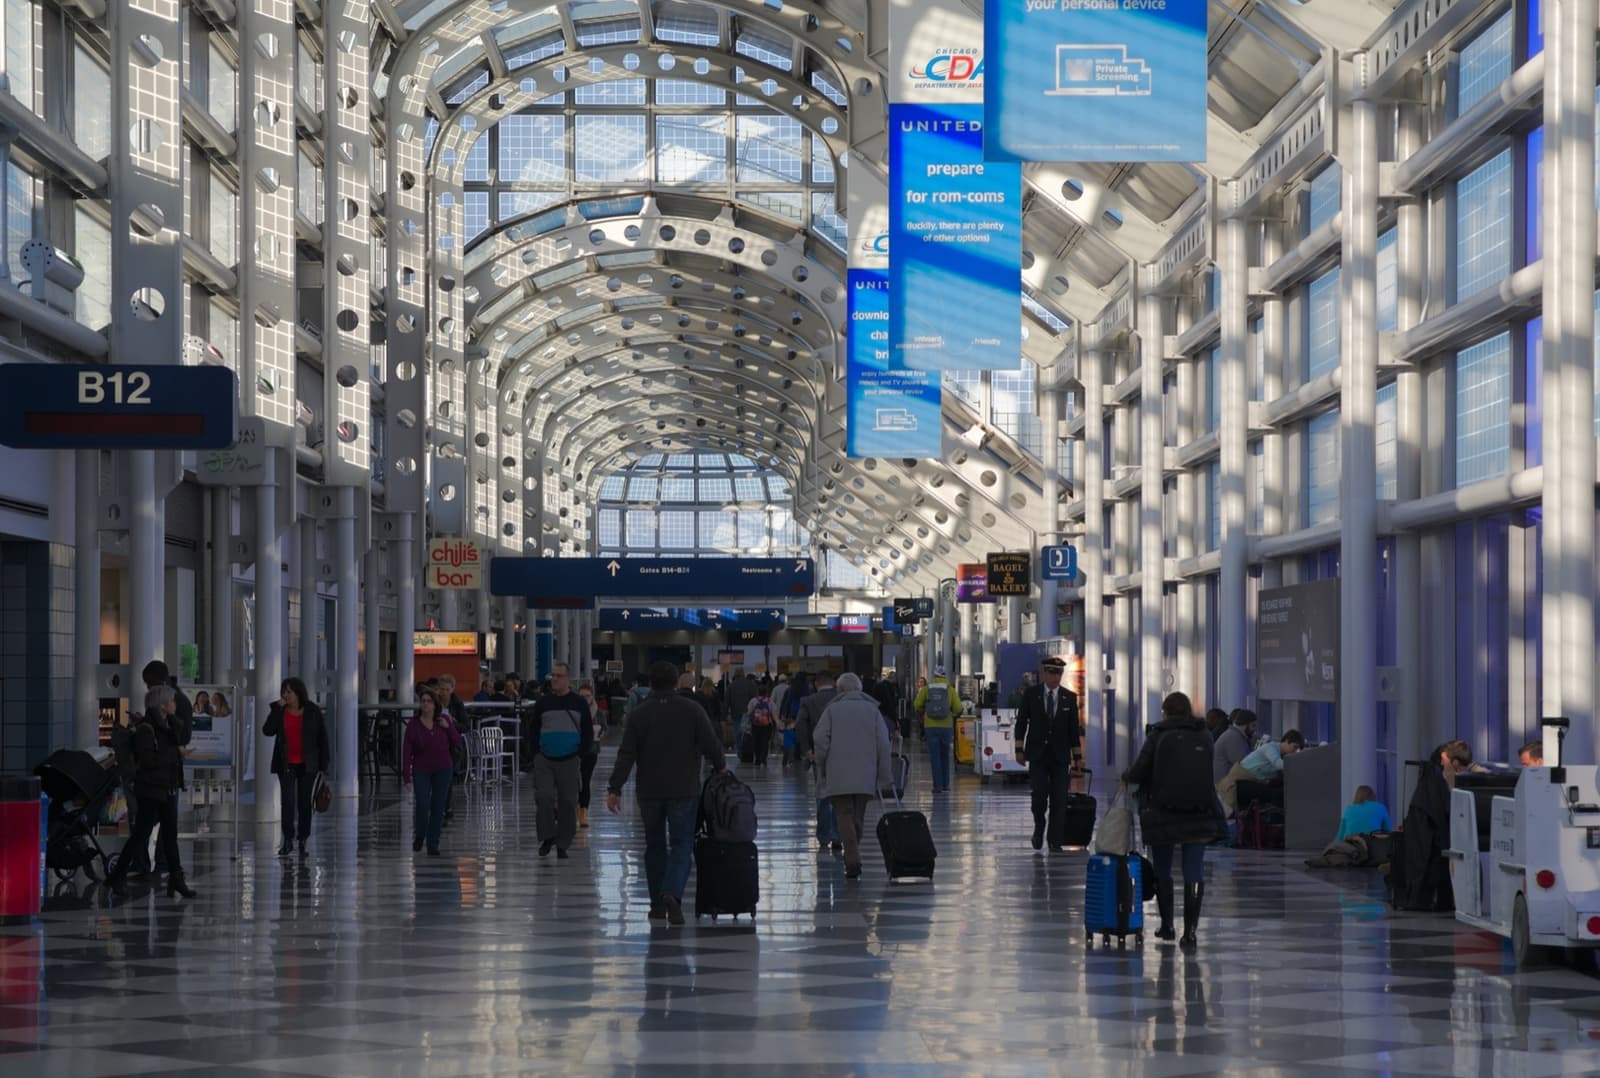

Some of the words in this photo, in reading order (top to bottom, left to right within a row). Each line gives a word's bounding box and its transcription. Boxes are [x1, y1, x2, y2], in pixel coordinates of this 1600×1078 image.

[1026, 0, 1056, 12] your
[1061, 0, 1118, 12] personal
[1123, 0, 1166, 10] device
[1095, 65, 1128, 73] Private
[1095, 73, 1139, 82] Screening
[901, 120, 982, 132] UNITED
[927, 163, 984, 177] prepare
[906, 190, 928, 203] for
[932, 191, 1005, 203] rom-coms
[939, 222, 960, 231] there
[978, 222, 1005, 232] plenty
[922, 234, 932, 242] of
[934, 234, 954, 242] other
[78, 371, 151, 404] B12
[640, 566, 660, 574] Gates
[993, 564, 1024, 573] BAGEL
[436, 567, 473, 587] bar
[990, 584, 1027, 593] BAKERY
